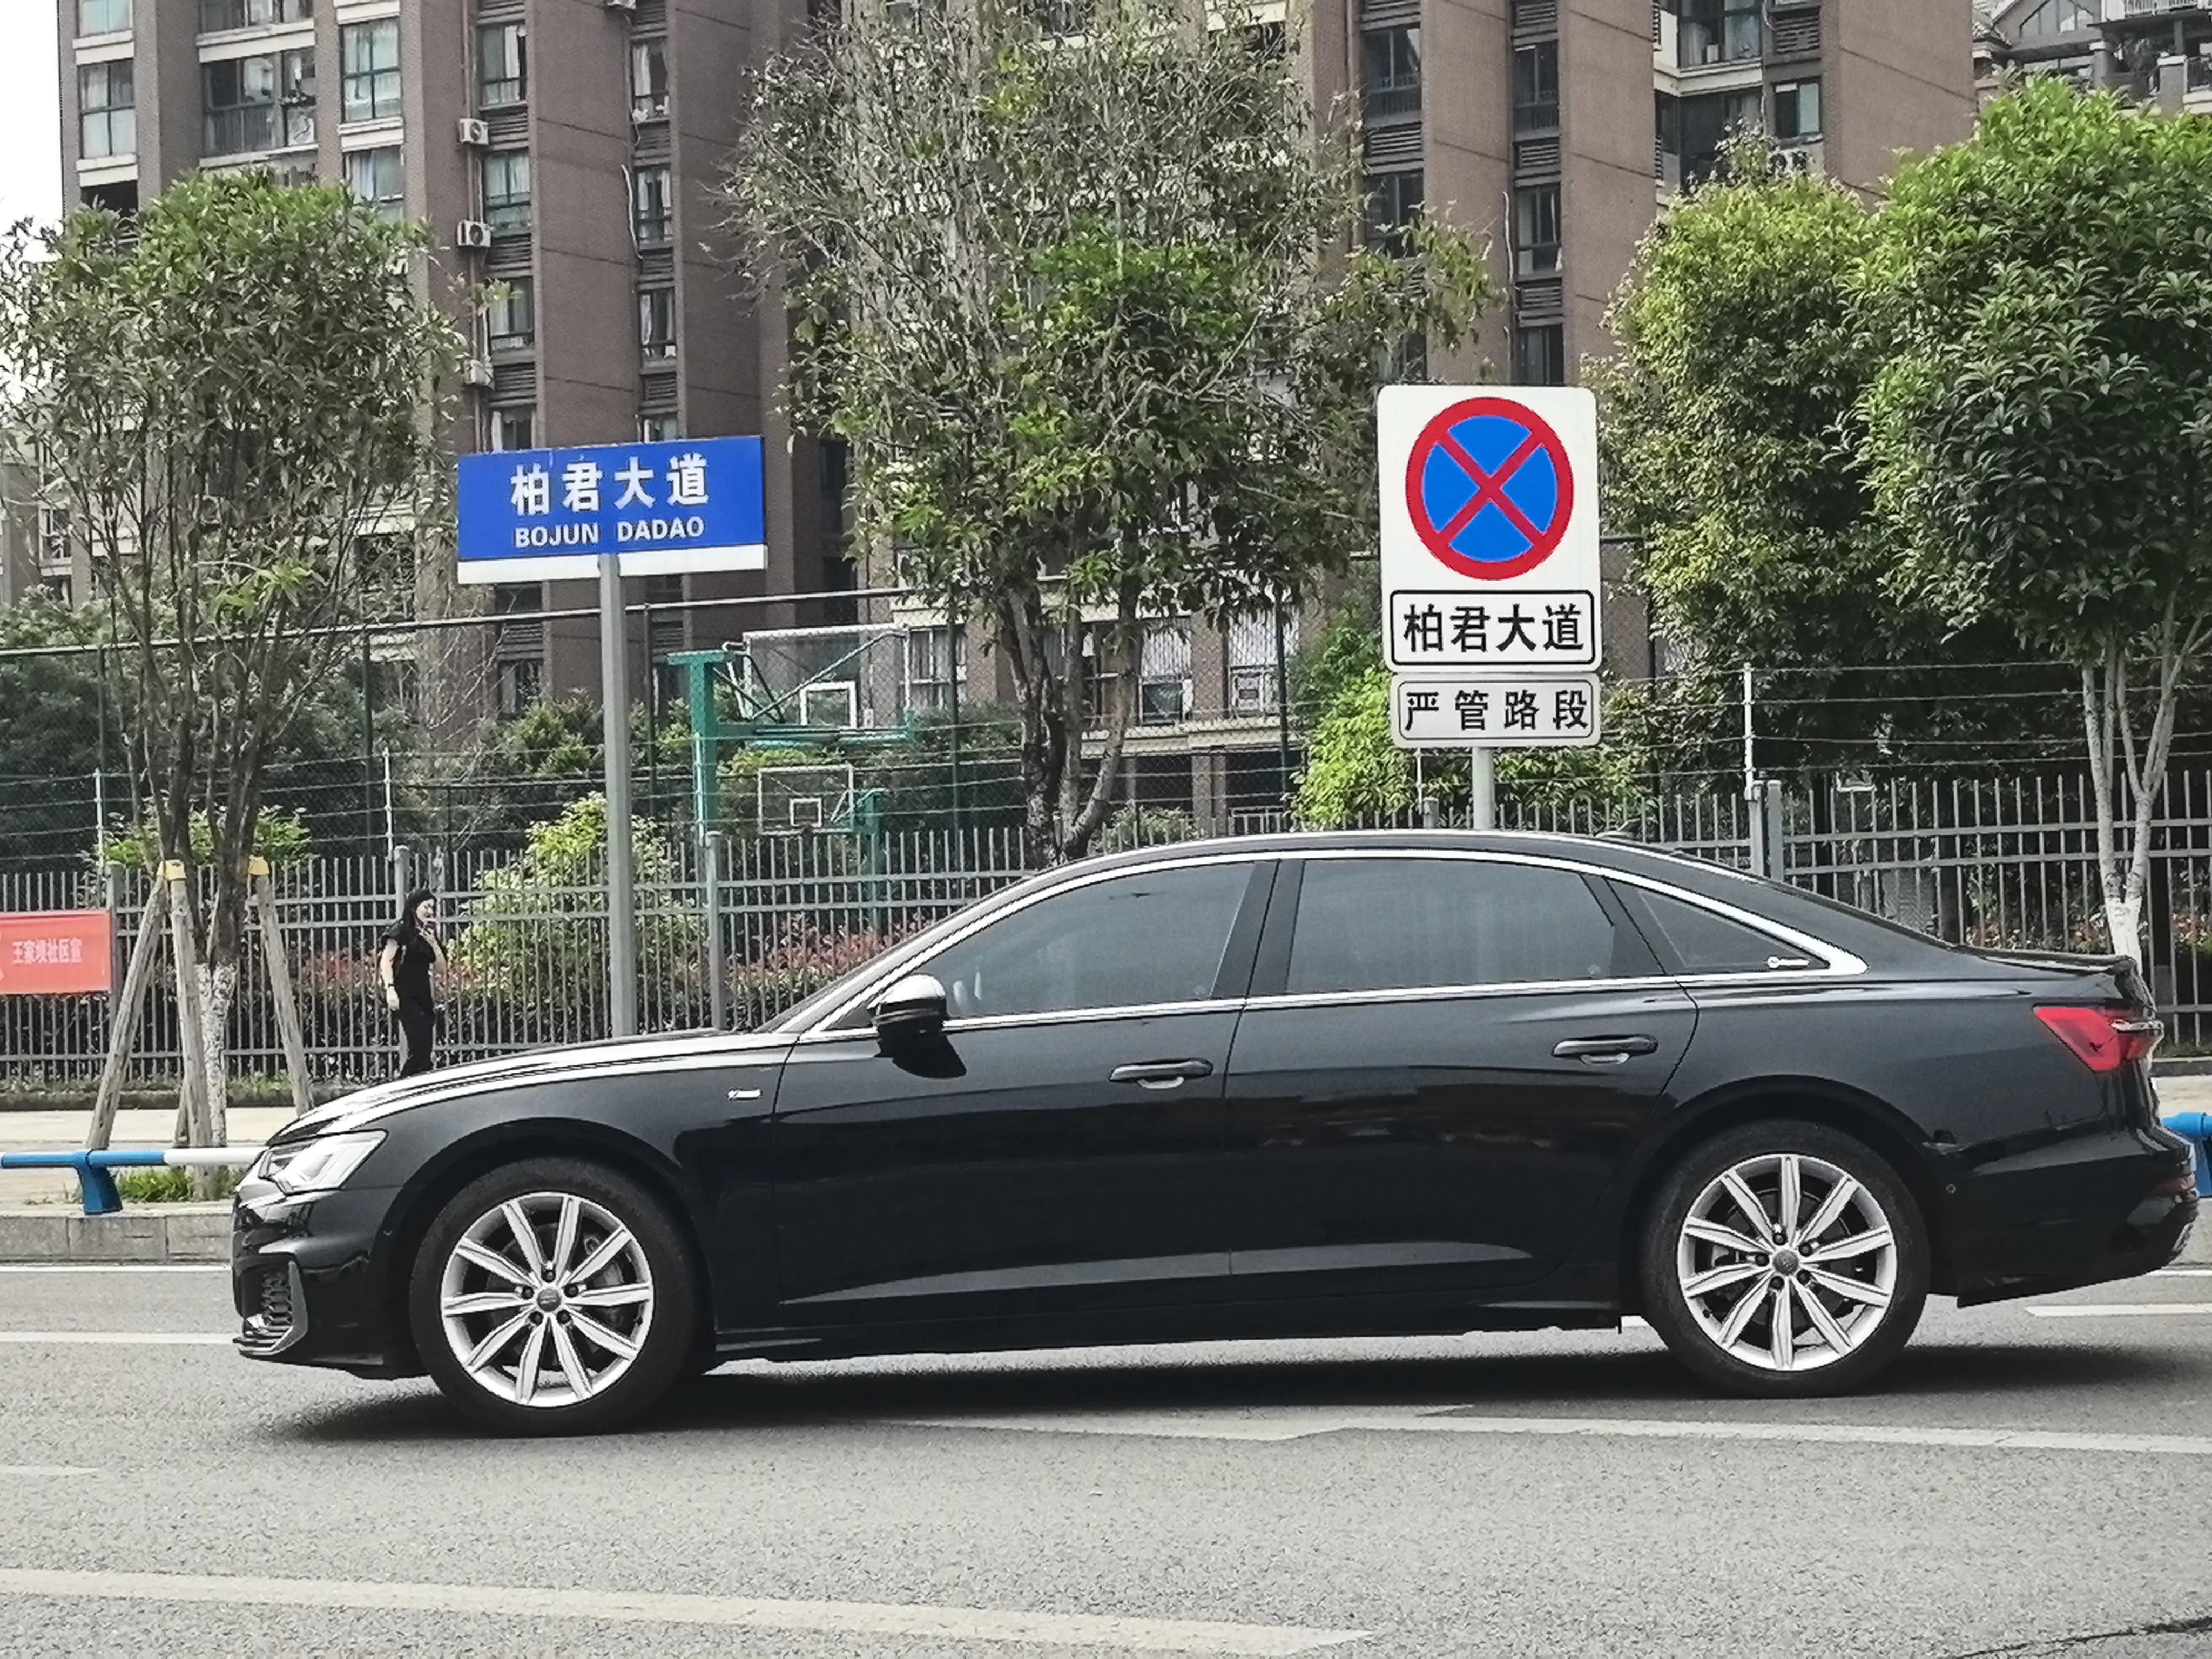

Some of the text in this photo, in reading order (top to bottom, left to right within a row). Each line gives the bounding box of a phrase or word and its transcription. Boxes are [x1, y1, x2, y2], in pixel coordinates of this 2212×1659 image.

[510, 453, 710, 516] 柏君大道
[514, 516, 705, 549] BOJUN DADAO
[1403, 603, 1584, 653] 柏君大道
[1405, 690, 1588, 731] 严管路段
